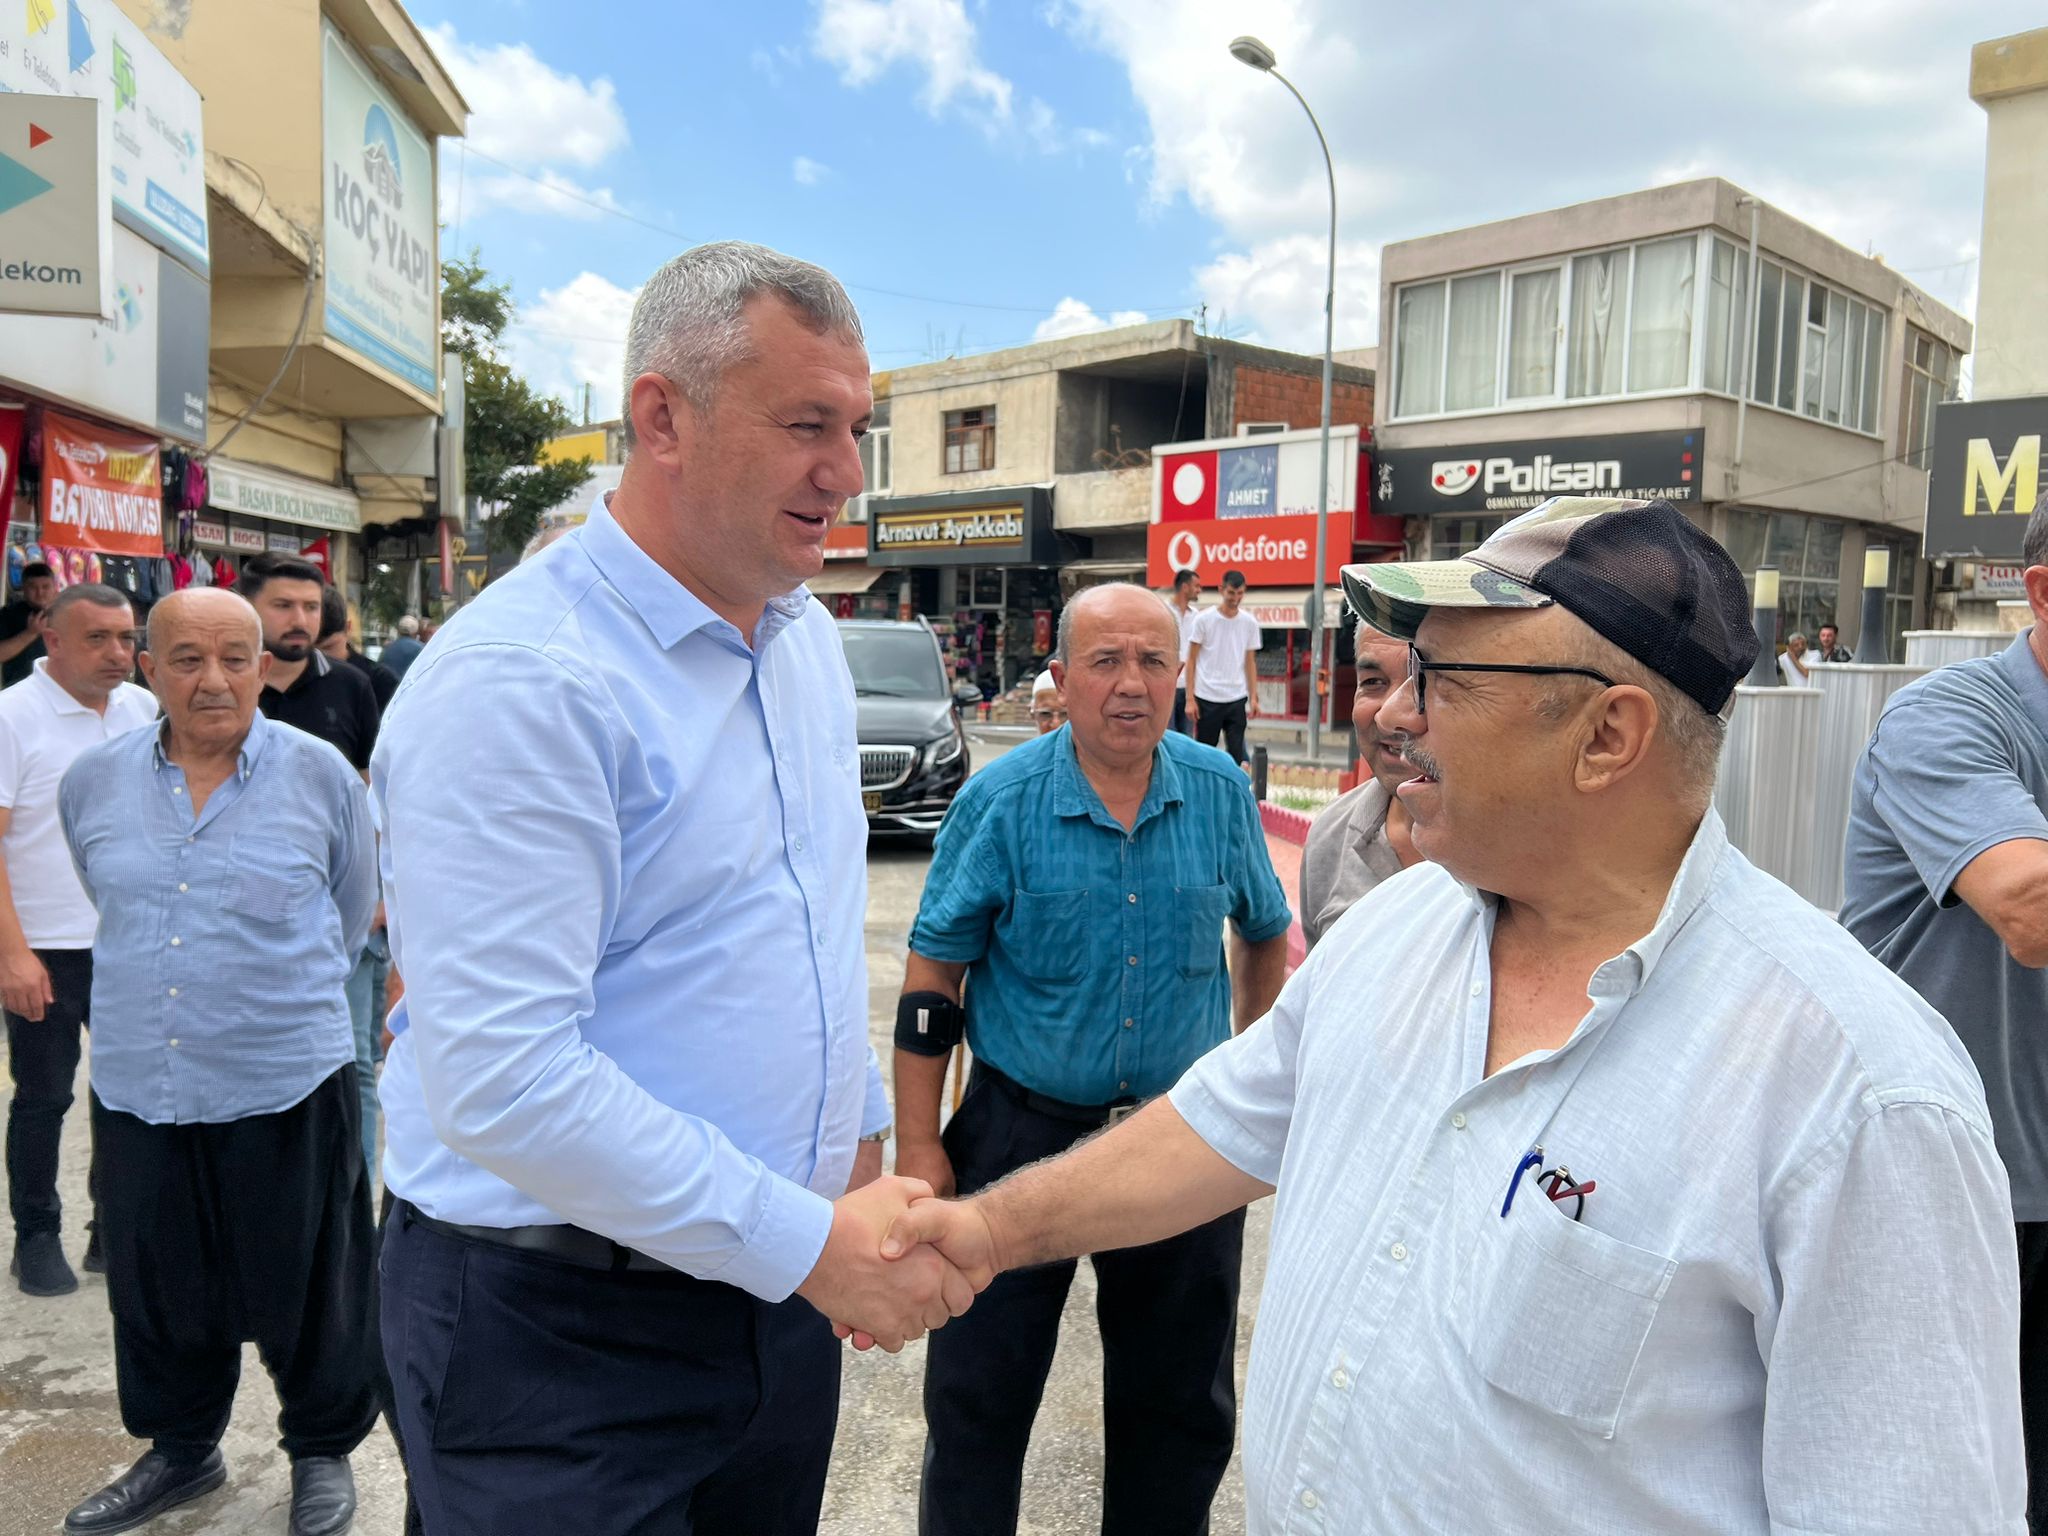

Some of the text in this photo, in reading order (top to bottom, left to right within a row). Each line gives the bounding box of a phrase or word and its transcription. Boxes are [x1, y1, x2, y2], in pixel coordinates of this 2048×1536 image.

[333, 160, 380, 264] KOÇ
[384, 211, 429, 297] YAPI
[1484, 455, 1620, 494] Polisan
[239, 485, 273, 513] HASAN
[275, 493, 301, 518] HOCA
[1227, 488, 1269, 507] AHMET
[233, 531, 263, 547] HOCA
[877, 514, 1023, 546] Arnavut Ayakkabı
[1204, 534, 1307, 564] vodafone
